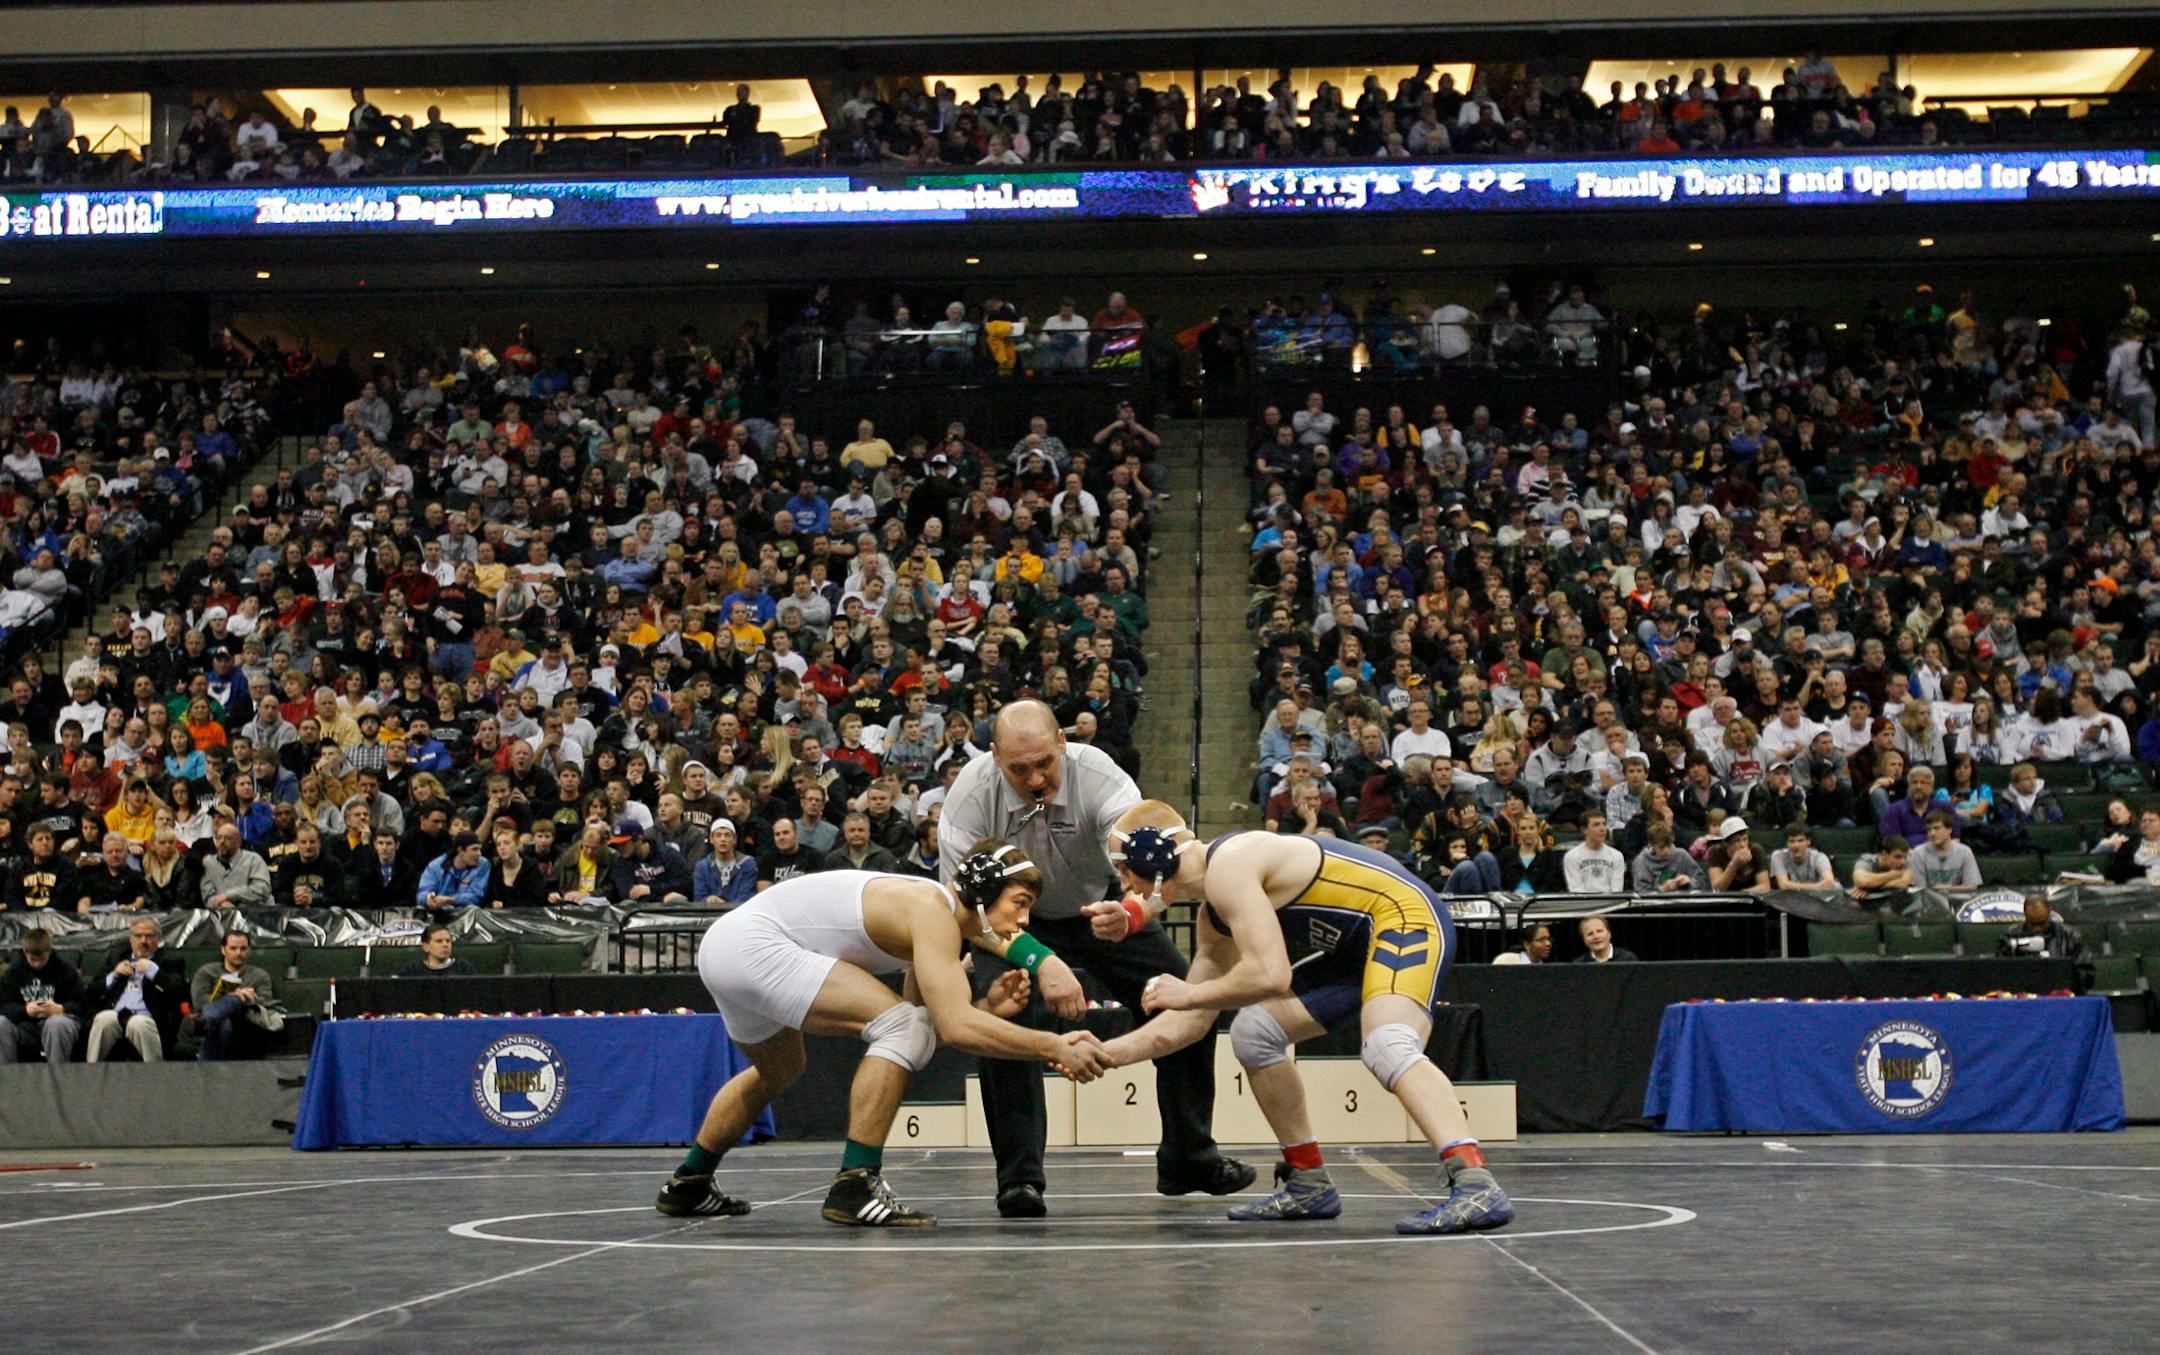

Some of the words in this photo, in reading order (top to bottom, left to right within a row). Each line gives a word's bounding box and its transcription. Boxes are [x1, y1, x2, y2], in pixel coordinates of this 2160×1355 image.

[1576, 169, 1676, 201] Family
[1788, 165, 1844, 193] and
[1853, 164, 1983, 196] Operated
[1990, 162, 2031, 189] for
[2037, 160, 2079, 189] 45
[396, 193, 483, 226] Begin
[484, 192, 554, 220] Here
[1868, 1022, 1938, 1045] MINNESOTA
[485, 1035, 553, 1059] MINNESOTA
[1877, 1058, 1933, 1081] MSHSL
[493, 1070, 547, 1094] MSHSL
[1125, 1082, 1137, 1106] 2
[1234, 1071, 1242, 1096] 1
[1345, 1090, 1358, 1113] 3
[906, 1115, 920, 1138] 6
